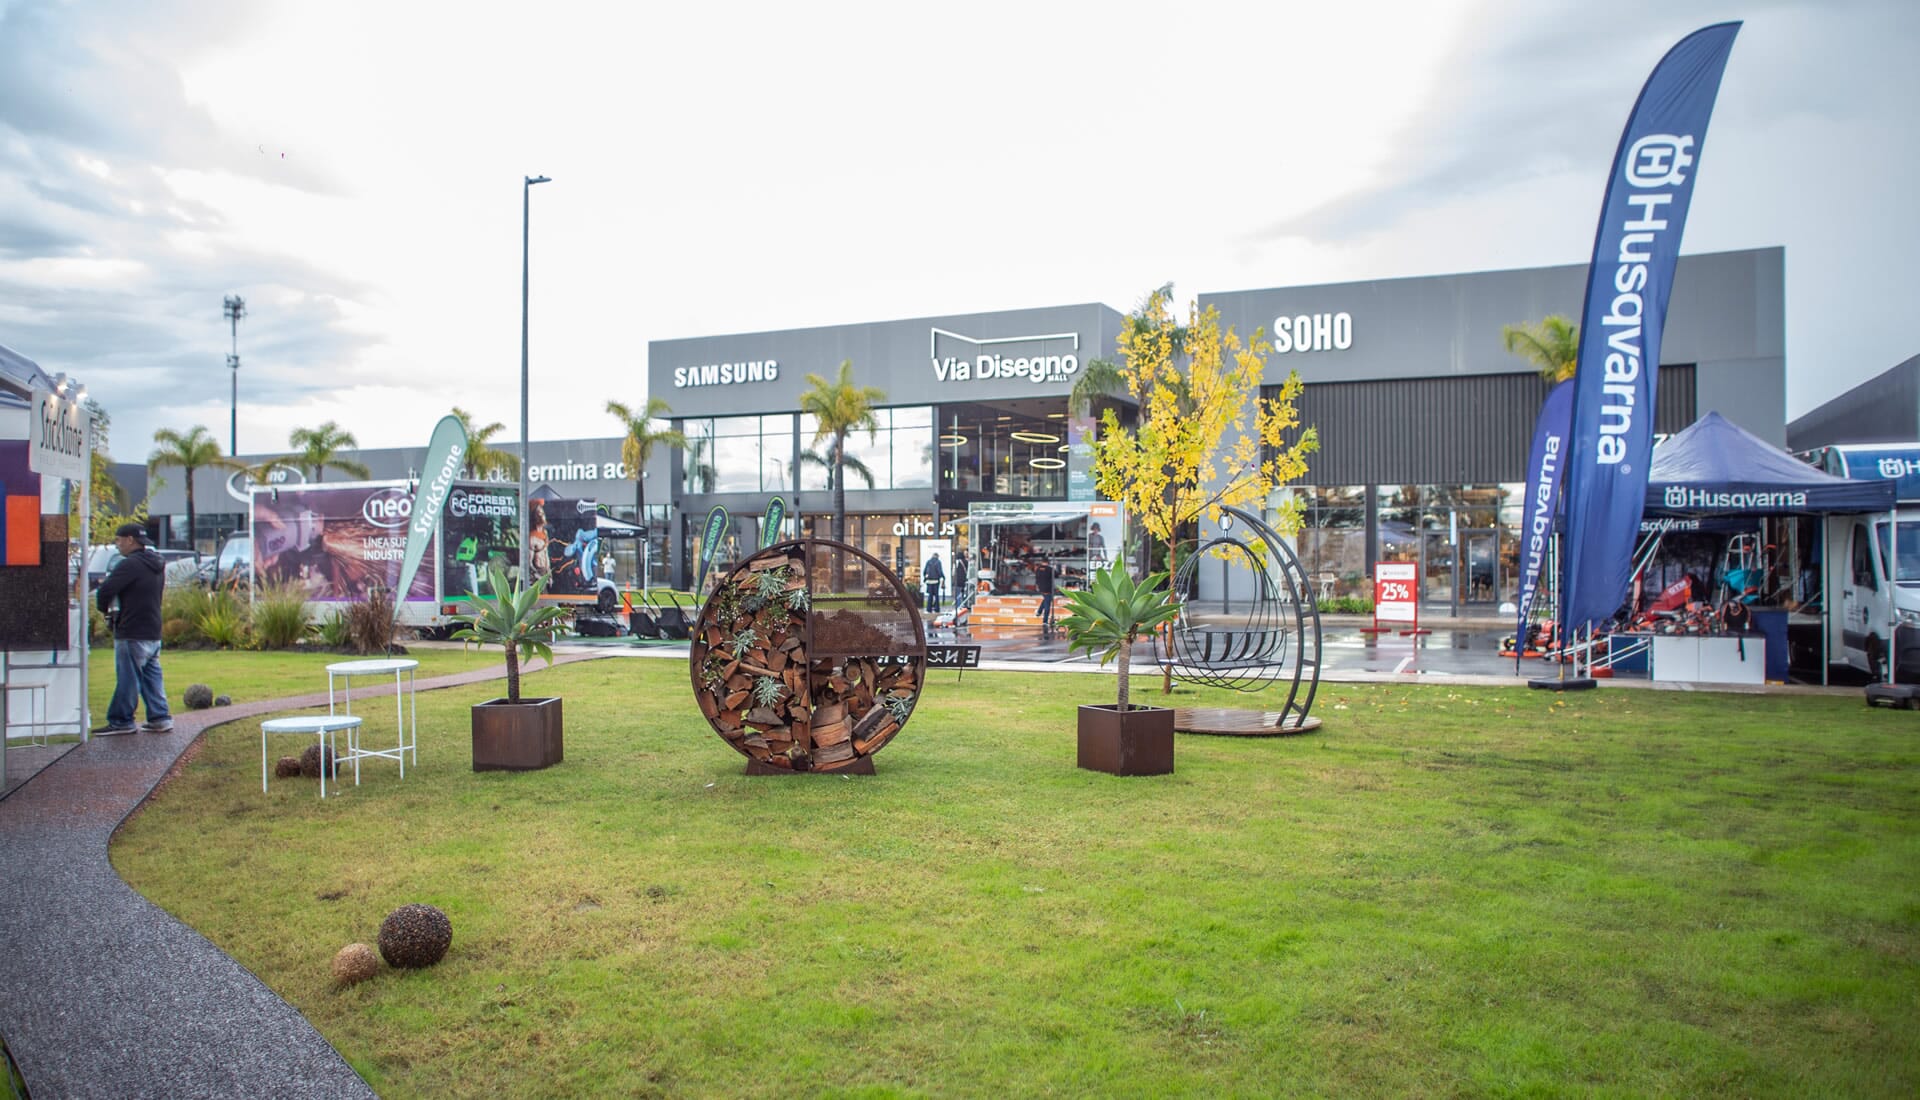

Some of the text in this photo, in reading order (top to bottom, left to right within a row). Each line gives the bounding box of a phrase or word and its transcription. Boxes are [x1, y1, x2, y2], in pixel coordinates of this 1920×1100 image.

[1274, 311, 1353, 354] SOHO
[1597, 193, 1673, 465] Husqvarna
[674, 359, 779, 388] SAMSUNG
[932, 353, 1079, 384] Via Disegno
[41, 400, 82, 458] StickStone
[528, 460, 598, 482] ermina
[414, 444, 463, 538] StickStone
[1689, 488, 1808, 508] Husqvarna
[370, 497, 412, 518] neo
[468, 504, 517, 516] GARDEN
[1524, 435, 1561, 592] Husqvarna
[1640, 519, 1700, 532] sqvarna
[363, 549, 405, 561] INDUSTR
[1382, 582, 1409, 601] 25%
